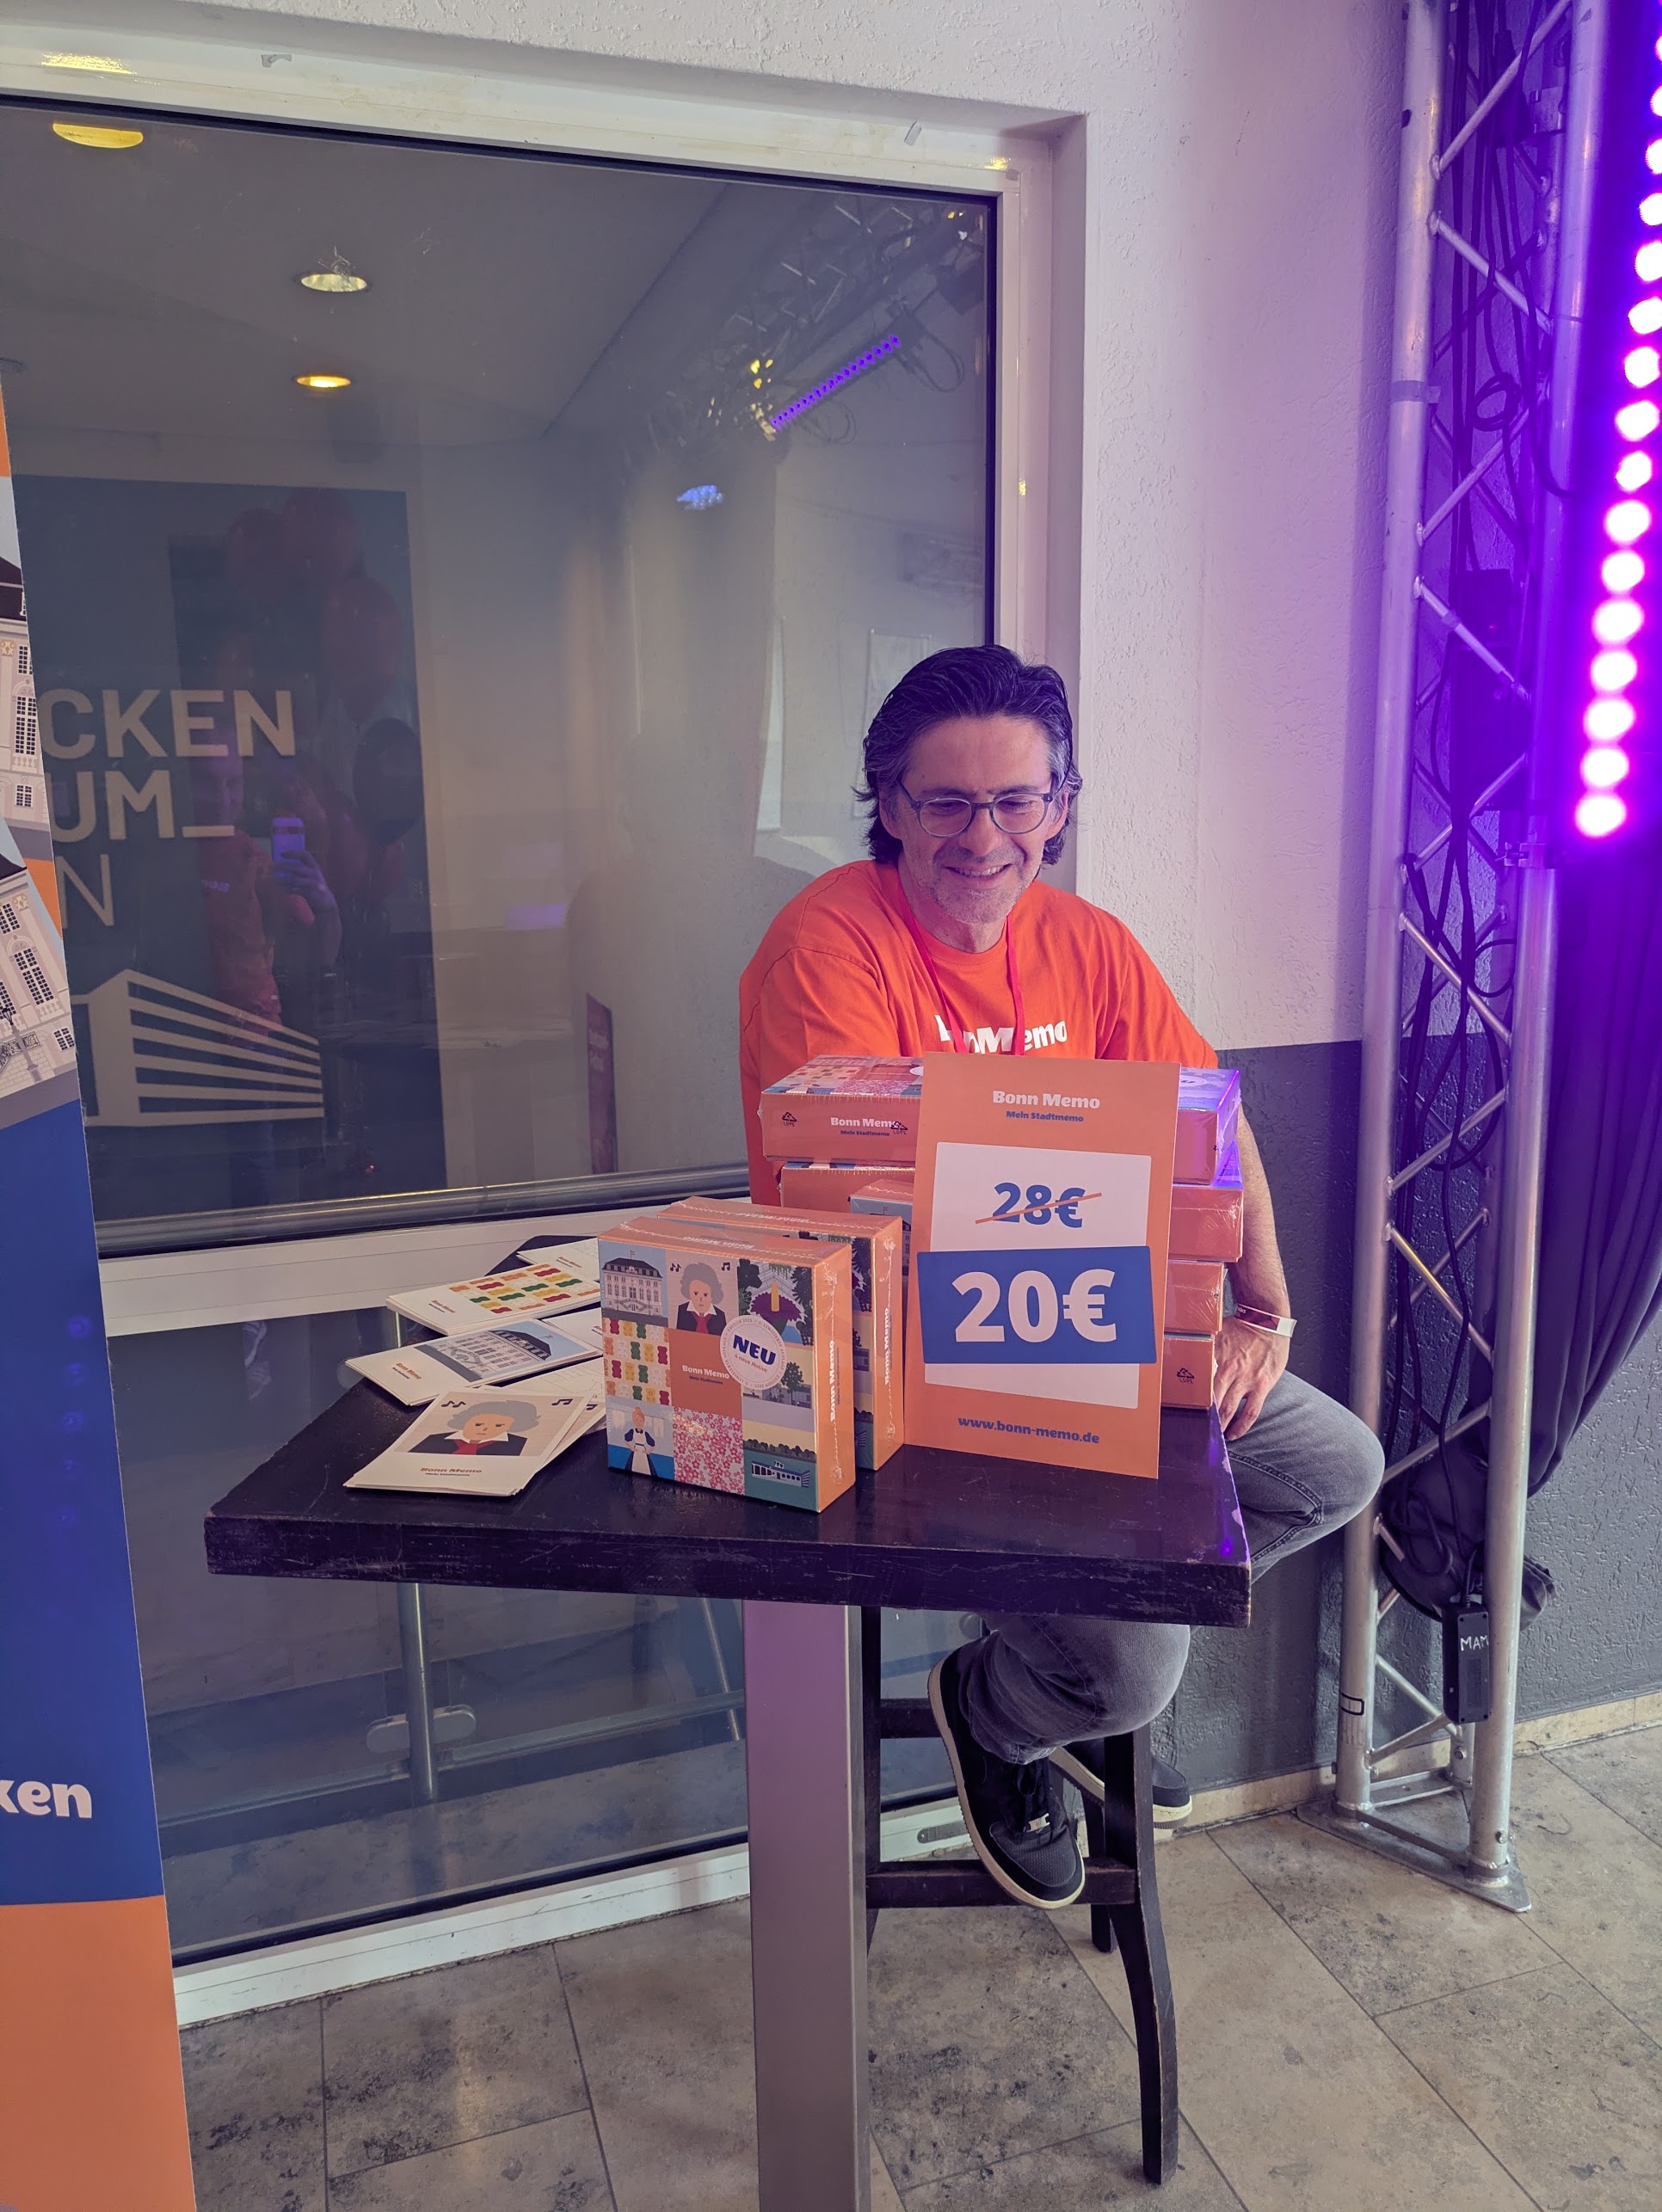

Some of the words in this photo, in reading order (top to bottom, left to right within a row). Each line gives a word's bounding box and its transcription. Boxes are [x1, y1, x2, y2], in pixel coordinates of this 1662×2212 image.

[993, 1090, 1038, 1105] Bonn
[1043, 1093, 1100, 1109] Memo
[830, 1116, 860, 1127] Bonn
[1006, 1110, 1029, 1119] Mein
[1031, 1112, 1084, 1122] Stadtmemo
[992, 1181, 1086, 1229] 28€
[951, 1268, 1117, 1343] 20€
[733, 1334, 776, 1366] NEU
[682, 1365, 703, 1374] Bonn
[704, 1368, 730, 1379] Memo
[751, 1361, 768, 1373] Motive
[957, 1417, 1099, 1444] www.bonn-memo.de
